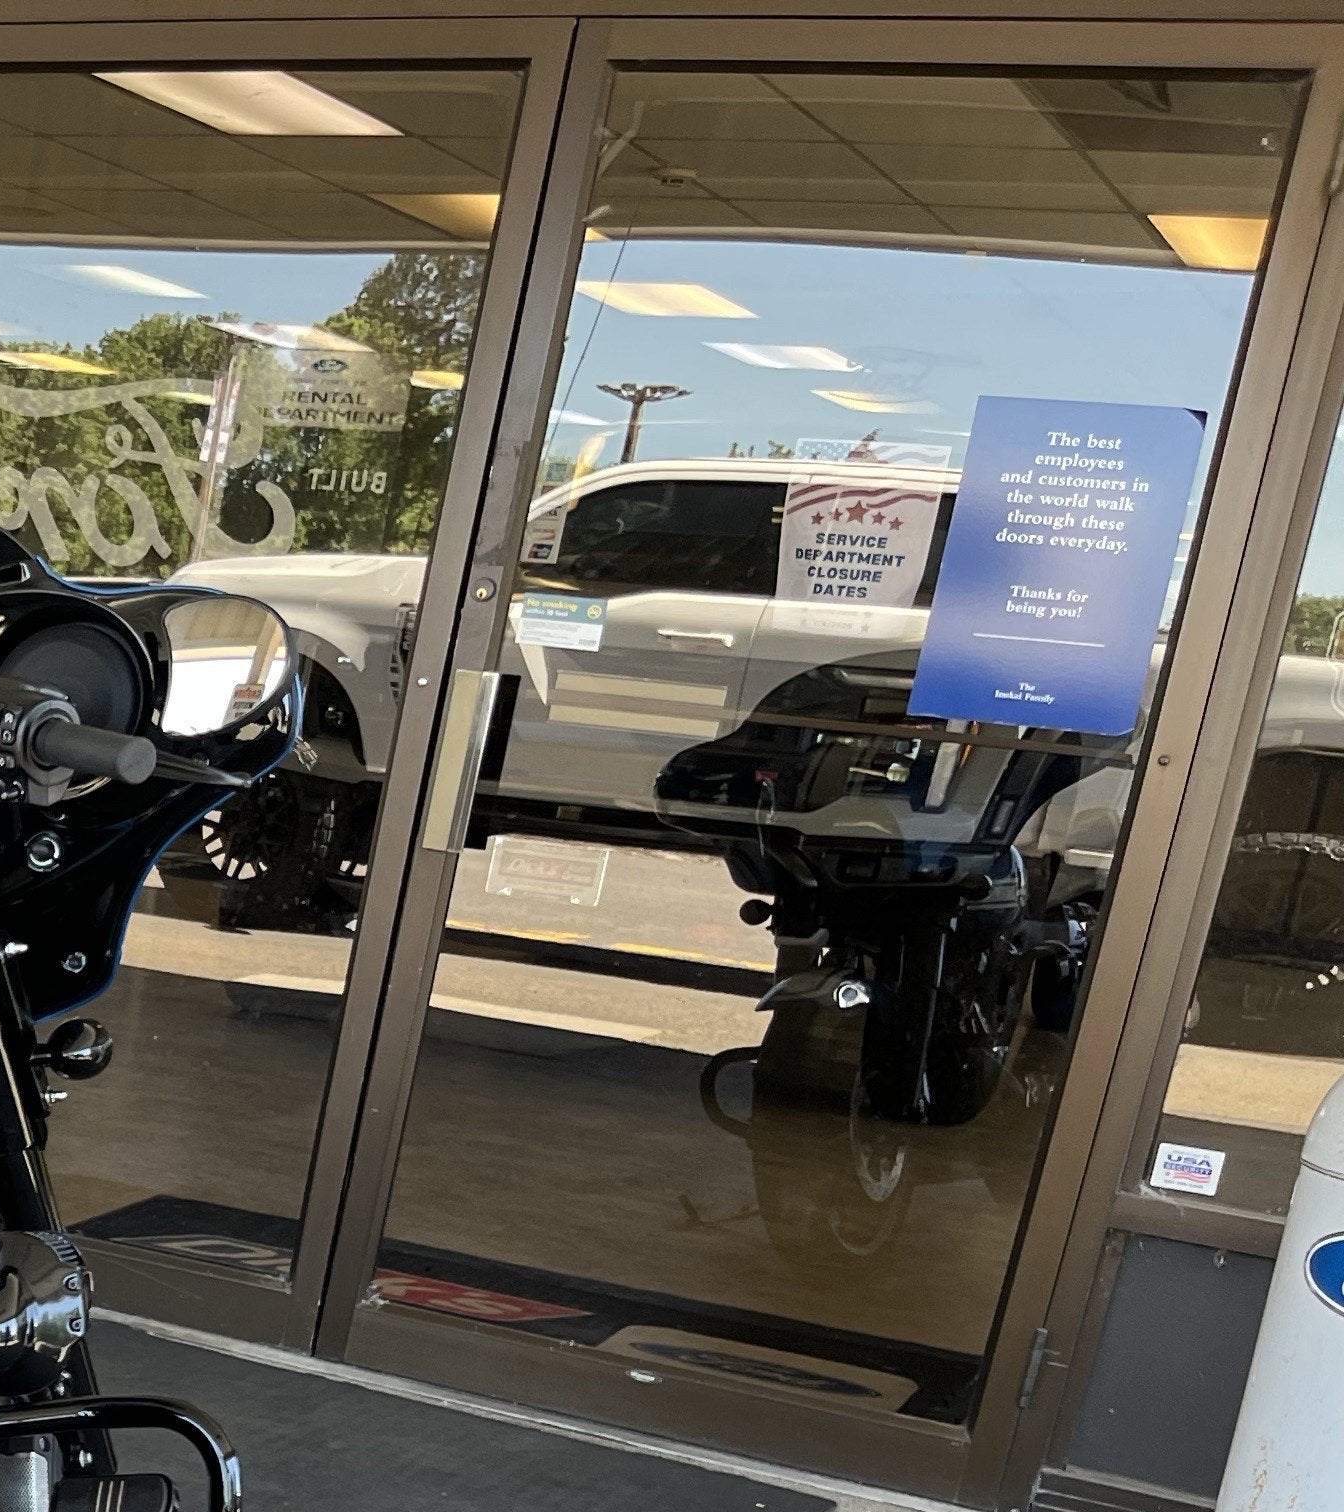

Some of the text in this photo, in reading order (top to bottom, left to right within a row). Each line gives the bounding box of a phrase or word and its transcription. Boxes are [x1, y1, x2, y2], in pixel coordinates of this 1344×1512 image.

[280, 390, 369, 406] RENTAL
[1047, 431, 1122, 450] The best
[1034, 453, 1124, 472] employees
[1000, 469, 1150, 493] and customers in
[1006, 489, 1135, 512] the world walk
[1007, 509, 1126, 531] through these
[815, 532, 888, 549] SERVICE
[995, 527, 1128, 555] doors everyday.
[795, 547, 906, 567] DEPARTMENT
[807, 565, 883, 583] CLOSURE
[812, 583, 868, 598] DATES
[1009, 585, 1089, 603] Thanks for
[1005, 600, 1083, 619] being you!
[1019, 682, 1036, 691] The
[1024, 693, 1056, 705] Family
[1163, 1162, 1213, 1176] SECURITY
[1166, 1154, 1212, 1168] USA
